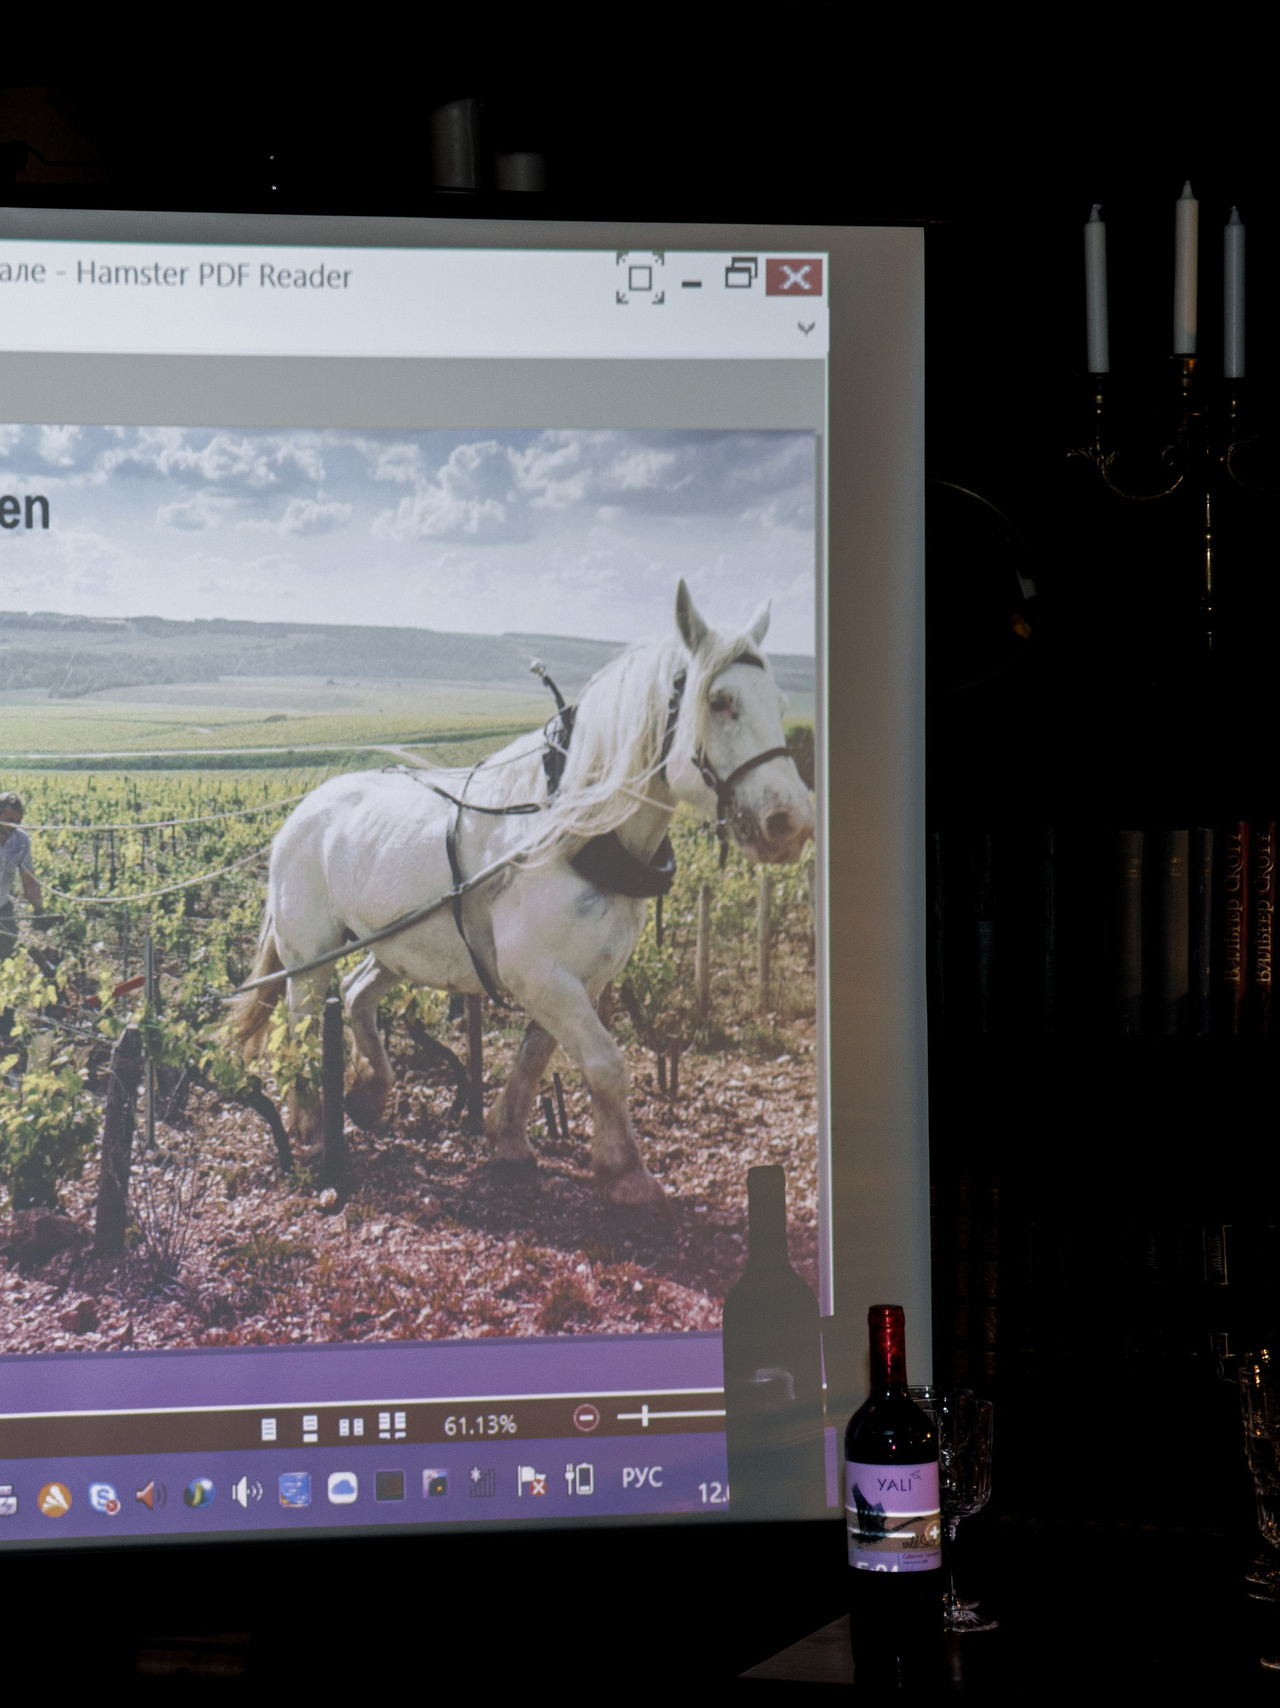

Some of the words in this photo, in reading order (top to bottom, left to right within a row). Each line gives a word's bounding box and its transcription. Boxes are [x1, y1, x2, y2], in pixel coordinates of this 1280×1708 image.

[77, 260, 189, 286] Hamster
[199, 262, 251, 288] PDF
[260, 263, 353, 289] Reader
[444, 1415, 518, 1436] 61.13%
[622, 1466, 663, 1488] РУС
[877, 1478, 912, 1492] YALI
